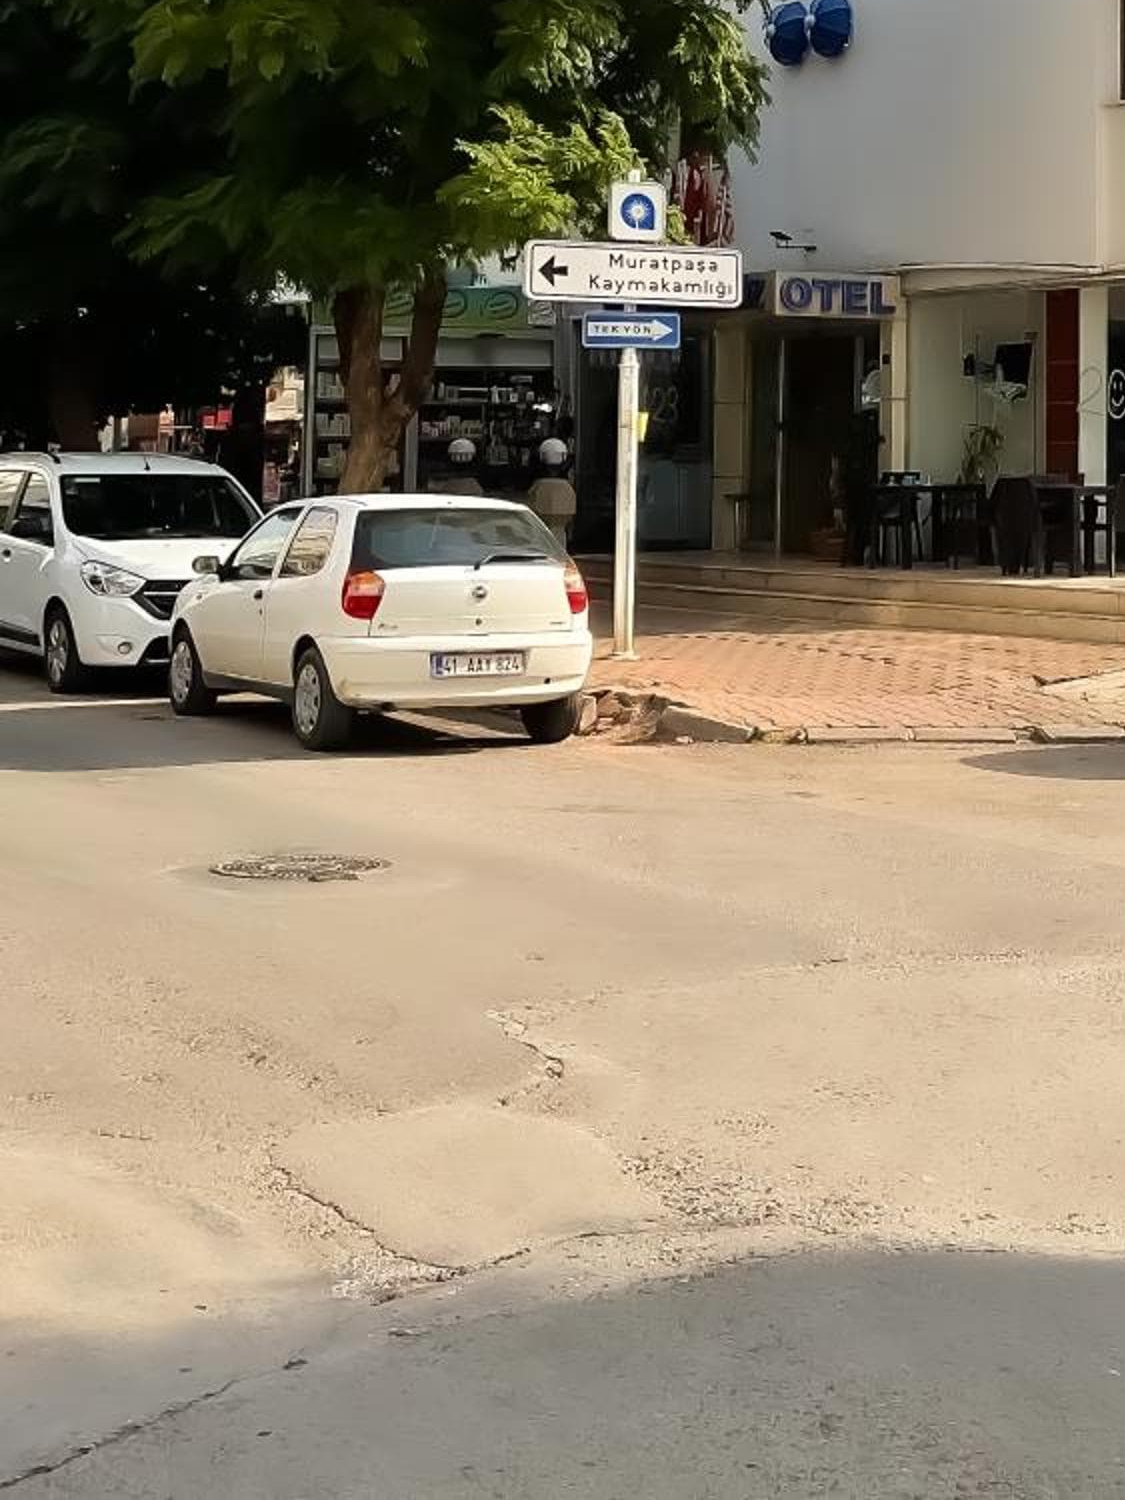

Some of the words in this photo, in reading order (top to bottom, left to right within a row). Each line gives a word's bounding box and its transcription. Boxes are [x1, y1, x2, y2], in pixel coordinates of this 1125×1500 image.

[608, 252, 719, 274] Muratpaşa
[588, 274, 733, 298] Kaymakamlığı
[780, 277, 896, 314] OTEL
